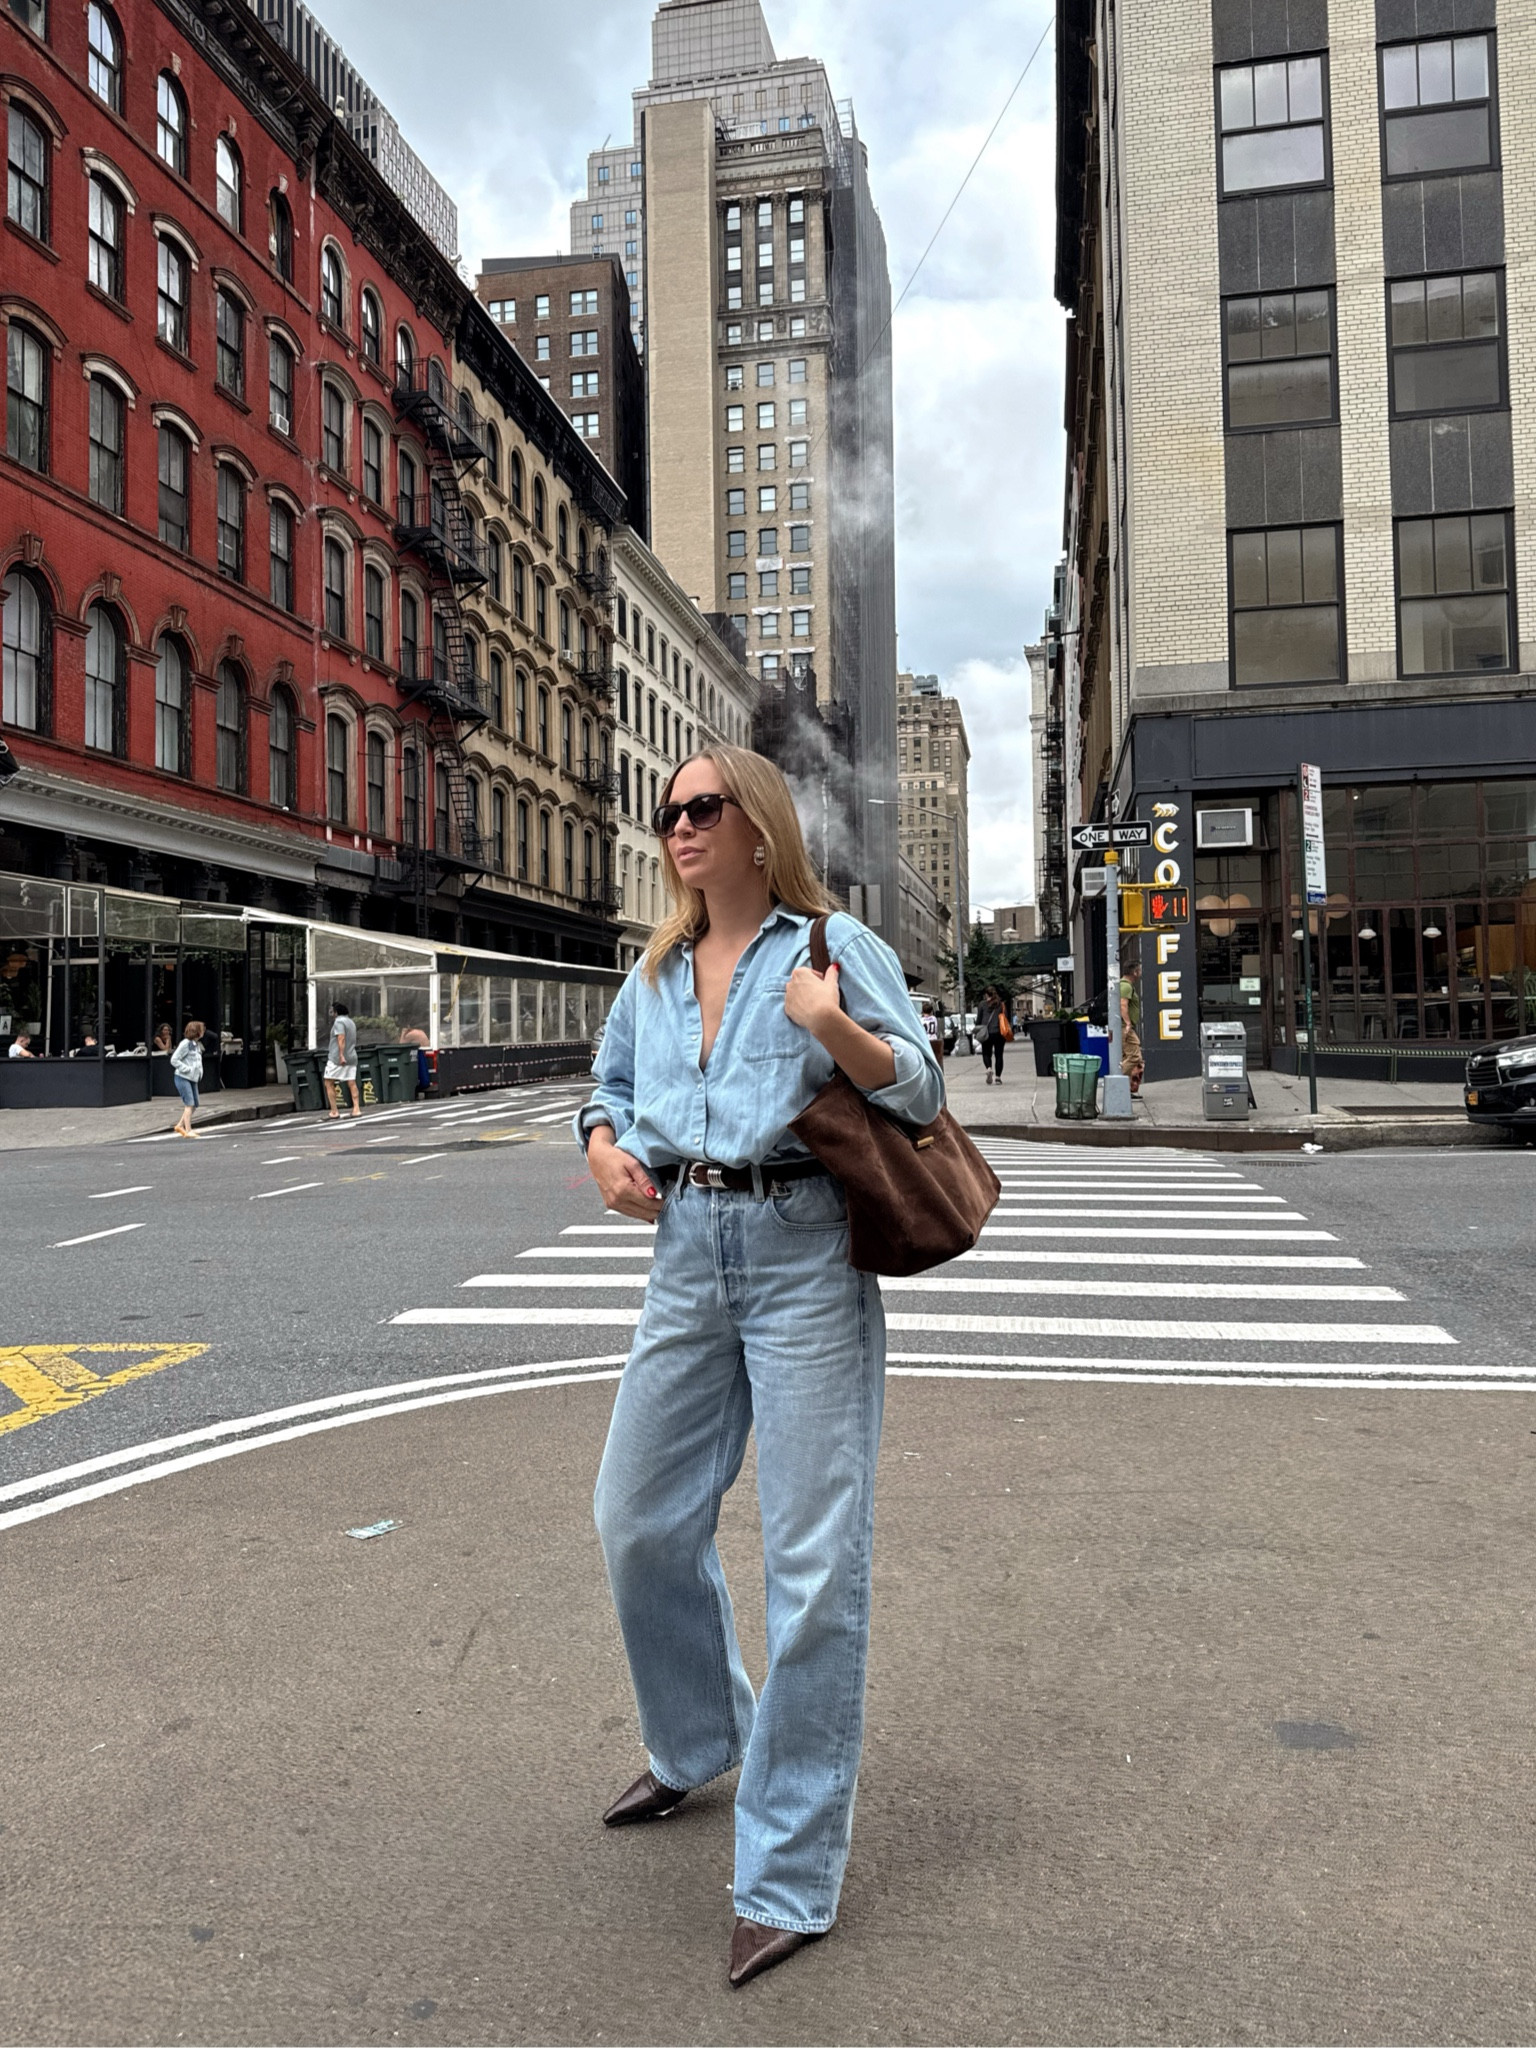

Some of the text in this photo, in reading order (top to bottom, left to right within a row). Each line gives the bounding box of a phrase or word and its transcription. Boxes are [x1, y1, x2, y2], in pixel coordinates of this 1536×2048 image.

[1080, 829, 1144, 842] ONE WAY
[1173, 896, 1186, 917] 11
[1154, 822, 1183, 1040] COFEE
